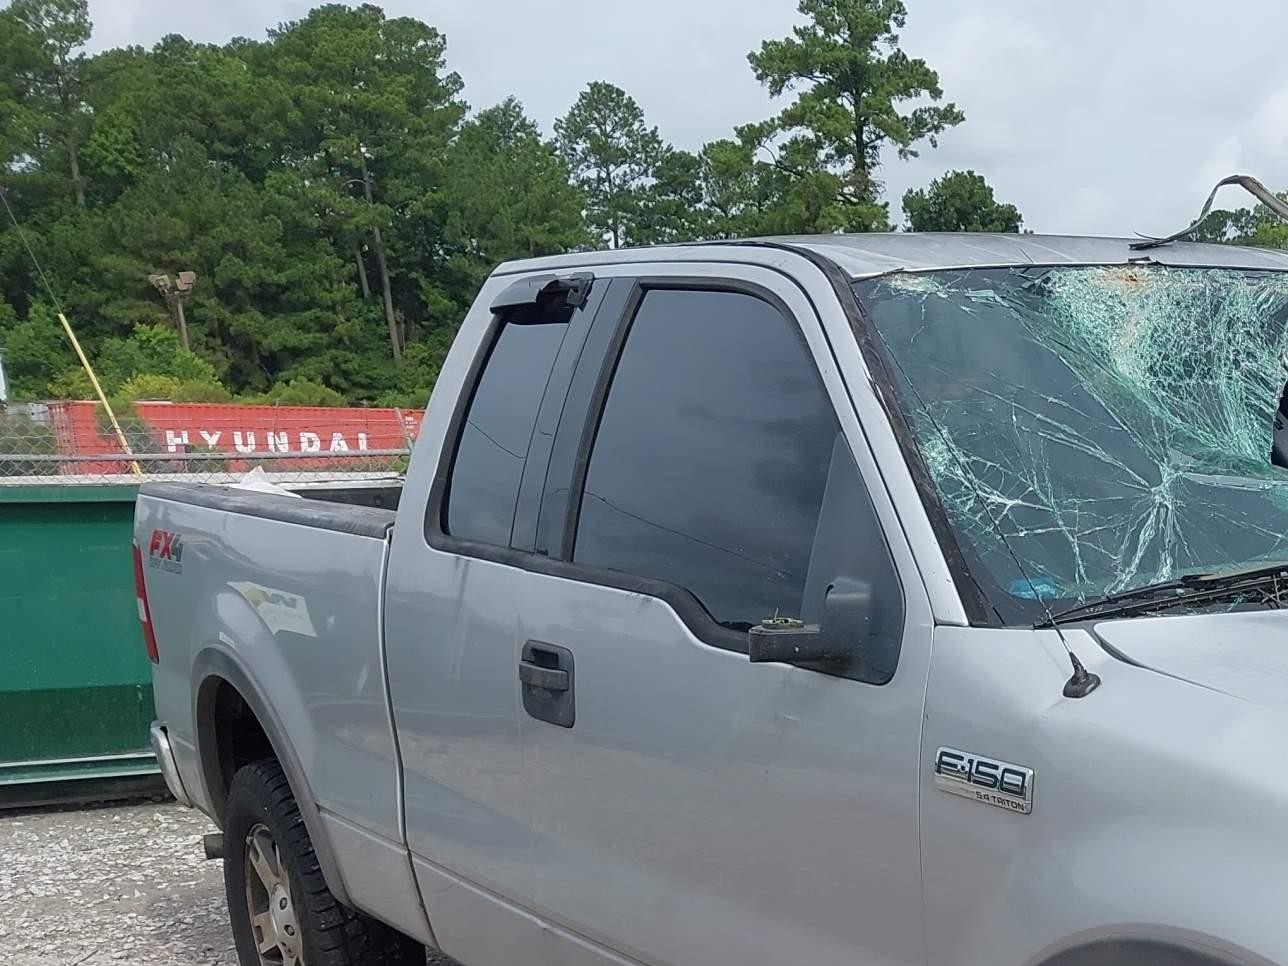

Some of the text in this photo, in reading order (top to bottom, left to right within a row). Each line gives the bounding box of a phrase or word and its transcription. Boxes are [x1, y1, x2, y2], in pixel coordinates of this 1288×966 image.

[165, 430, 371, 453] HYUNDAI
[149, 529, 184, 562] FX4
[991, 795, 1025, 811] TRITON
